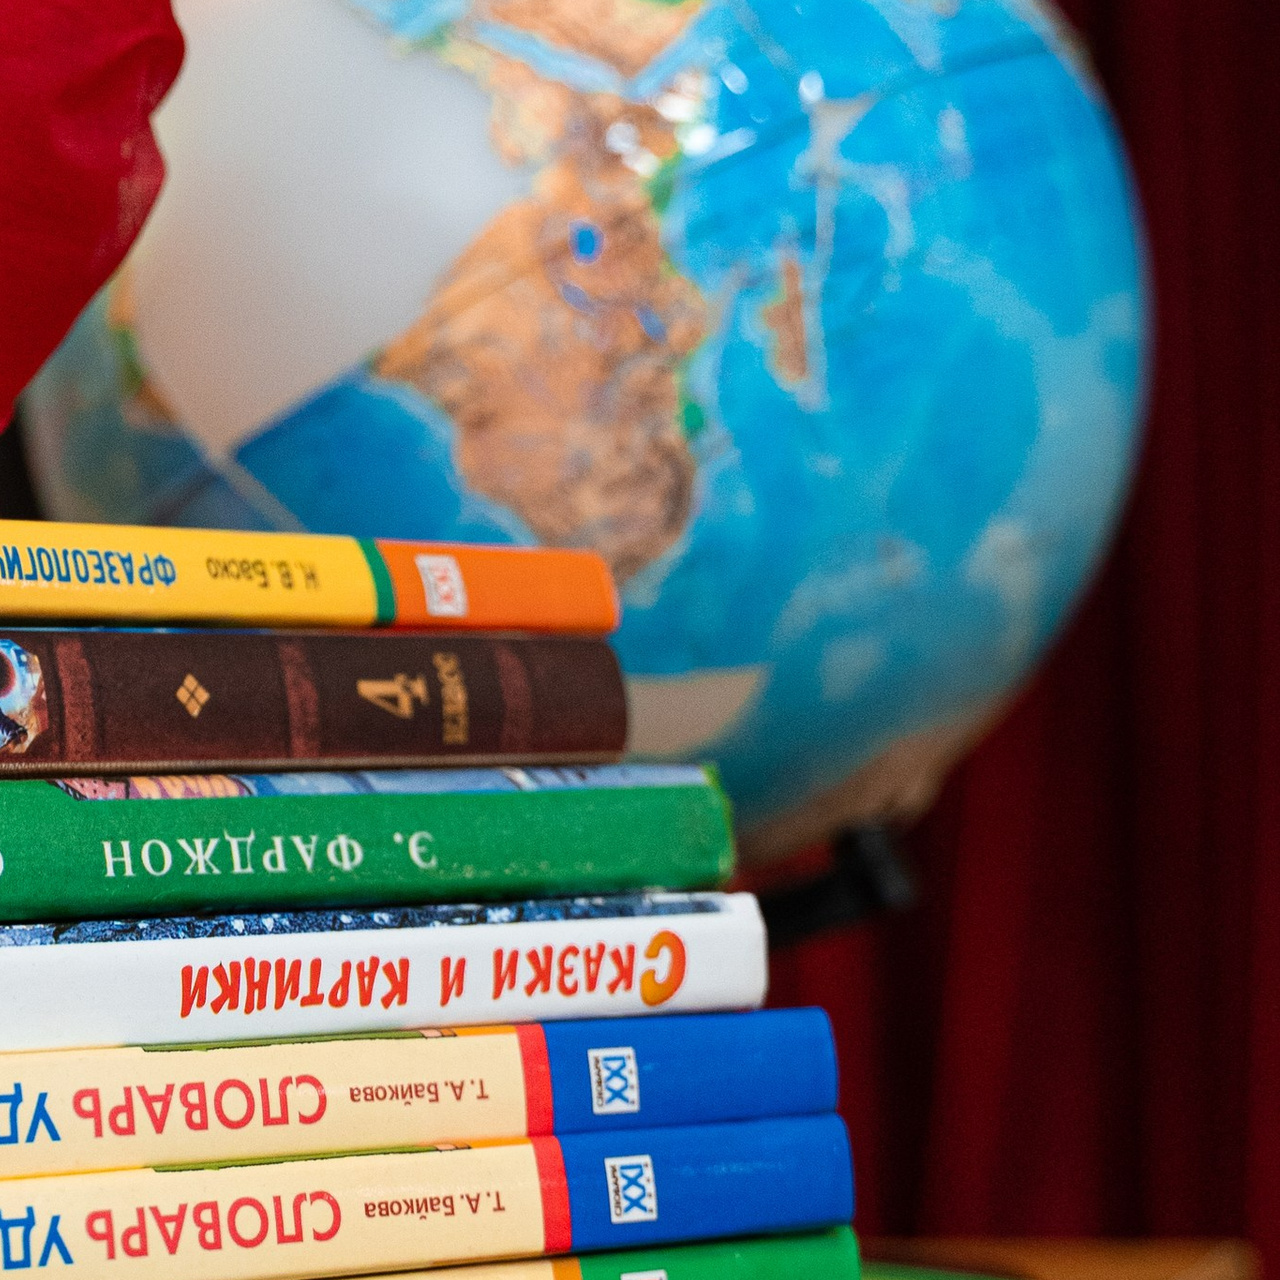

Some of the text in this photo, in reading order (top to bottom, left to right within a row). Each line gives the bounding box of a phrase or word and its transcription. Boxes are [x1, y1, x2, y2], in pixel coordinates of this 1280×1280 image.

[205, 556, 272, 589] Баско
[356, 673, 429, 719] 4
[102, 828, 438, 877] Э. ФАРДЖОН
[180, 955, 409, 1017] КАРТИНКИ
[439, 955, 467, 1005] И
[71, 1074, 329, 1138] СЛОВАРЬ
[349, 1079, 488, 1108] Т. А. Байкова
[85, 1191, 342, 1260] СЛОВАРЬ
[364, 1192, 505, 1223] Т. А. Байкова
